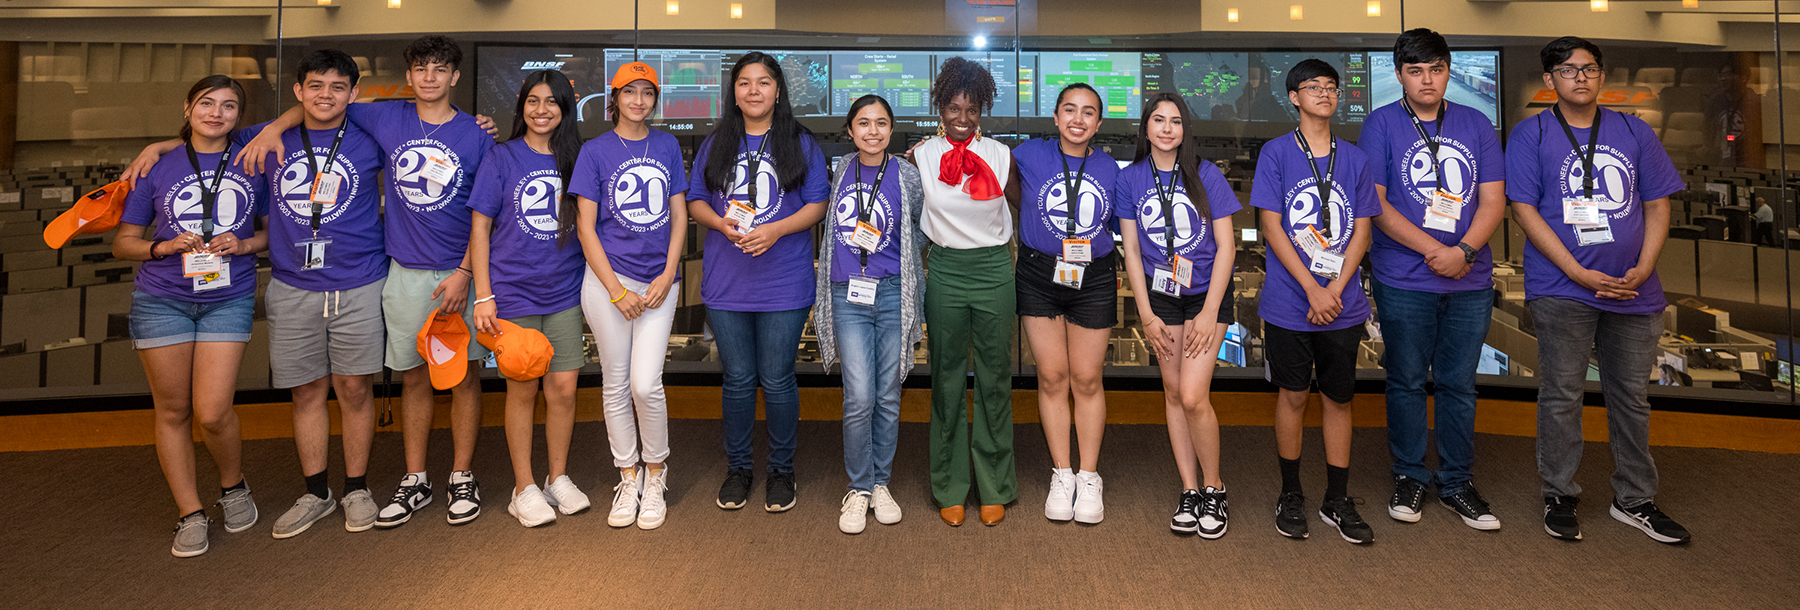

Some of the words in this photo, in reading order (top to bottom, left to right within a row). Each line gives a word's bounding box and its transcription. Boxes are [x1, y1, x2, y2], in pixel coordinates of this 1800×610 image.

[1532, 90, 1660, 104] BSF
[434, 140, 446, 150] FOR
[1453, 140, 1474, 161] SUPPLY
[337, 153, 358, 175] SUPPLY
[444, 148, 462, 168] SUPPLY
[619, 158, 642, 170] CENTER
[1401, 149, 1413, 172] NEELEY
[1560, 156, 1572, 181] NEELEY
[1610, 148, 1633, 169] SUPPLY
[232, 172, 254, 193] SUPPLY
[608, 171, 618, 197] NEELEY
[1401, 173, 1409, 186] TCU
[1410, 152, 1471, 195] 20
[164, 182, 182, 206] NEELEY
[513, 176, 527, 200] NEELEY
[615, 174, 668, 216] 20
[1039, 178, 1054, 198] NEELEY
[1094, 180, 1108, 201] SUPPLY
[1297, 177, 1317, 188] CENT
[1336, 184, 1350, 207] SUPPLY
[1410, 190, 1424, 204] 2003
[1560, 180, 1568, 194] TCU
[426, 188, 458, 213] INNOVATION
[878, 193, 893, 216] SUPPLY
[1046, 183, 1103, 228] 20
[278, 202, 292, 218] 2003
[295, 216, 310, 226] 2023
[614, 213, 627, 227] 2003
[1041, 216, 1053, 231] 2003
[1141, 198, 1199, 240] 20
[517, 218, 530, 234] 2003
[534, 232, 549, 240] 2023
